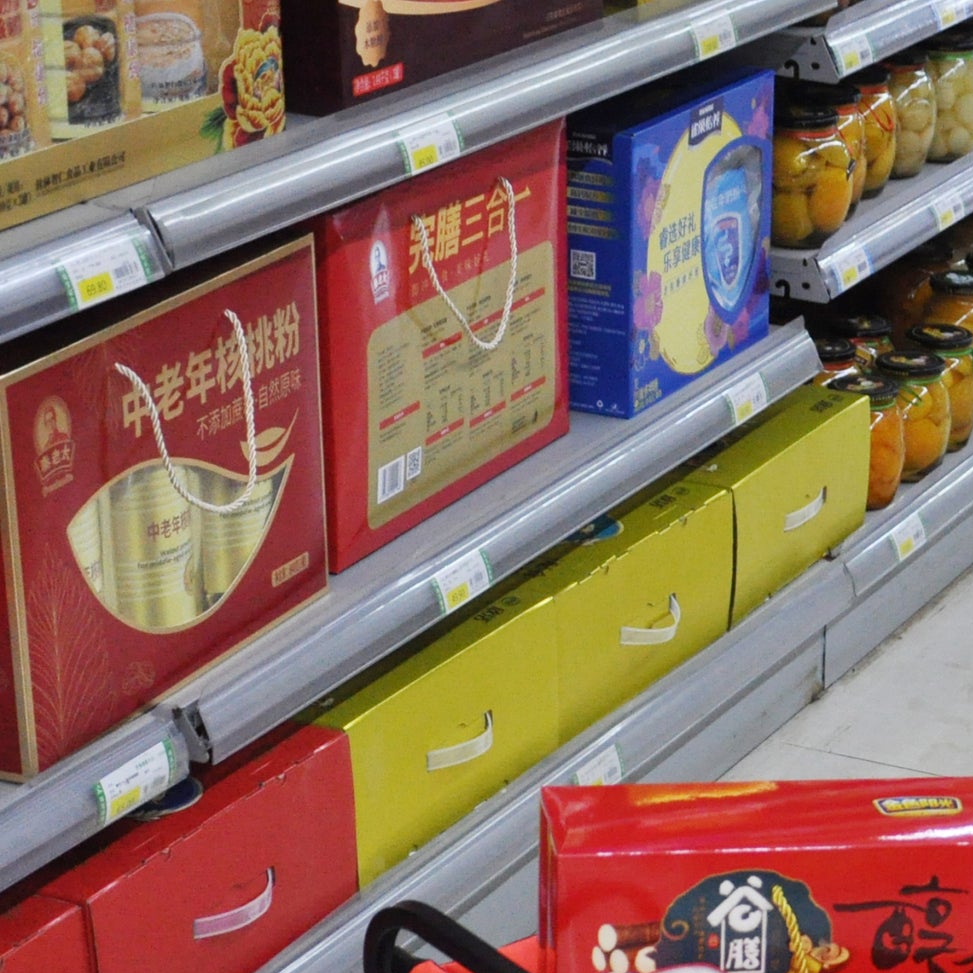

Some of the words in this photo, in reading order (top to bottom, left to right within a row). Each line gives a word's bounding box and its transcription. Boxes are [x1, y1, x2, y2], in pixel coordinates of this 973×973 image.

[122, 302, 300, 438] 中老年核桃粉
